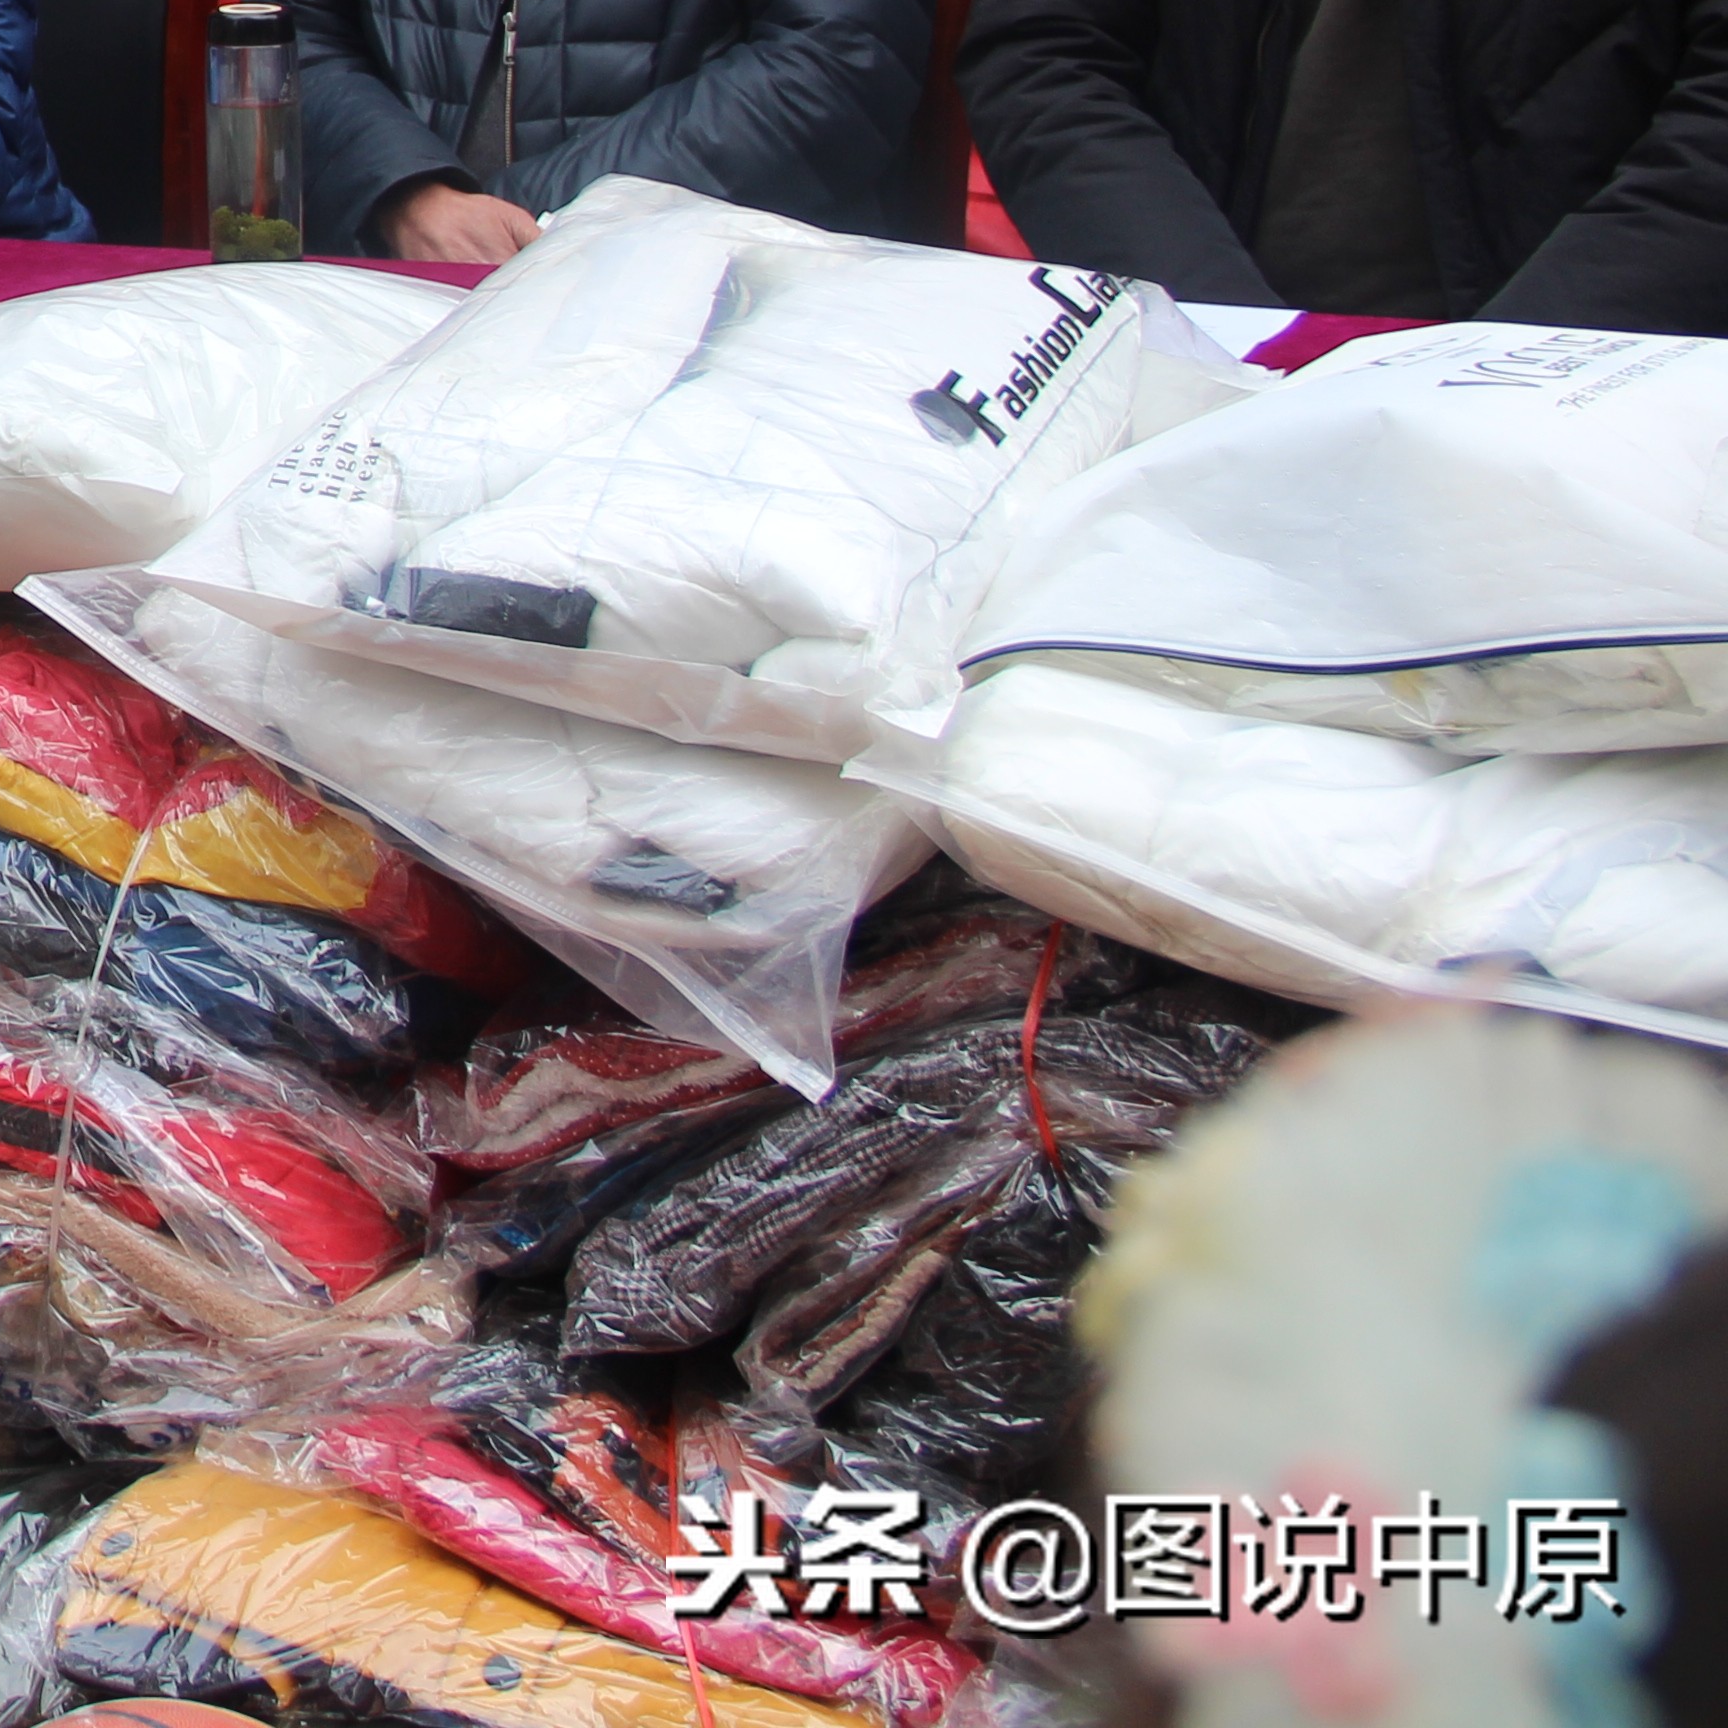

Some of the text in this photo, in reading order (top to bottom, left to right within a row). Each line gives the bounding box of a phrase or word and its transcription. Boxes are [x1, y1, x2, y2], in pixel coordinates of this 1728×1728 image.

[267, 443, 305, 490] The
[299, 410, 348, 494] classic
[318, 440, 358, 499] high
[349, 437, 382, 503] wear
